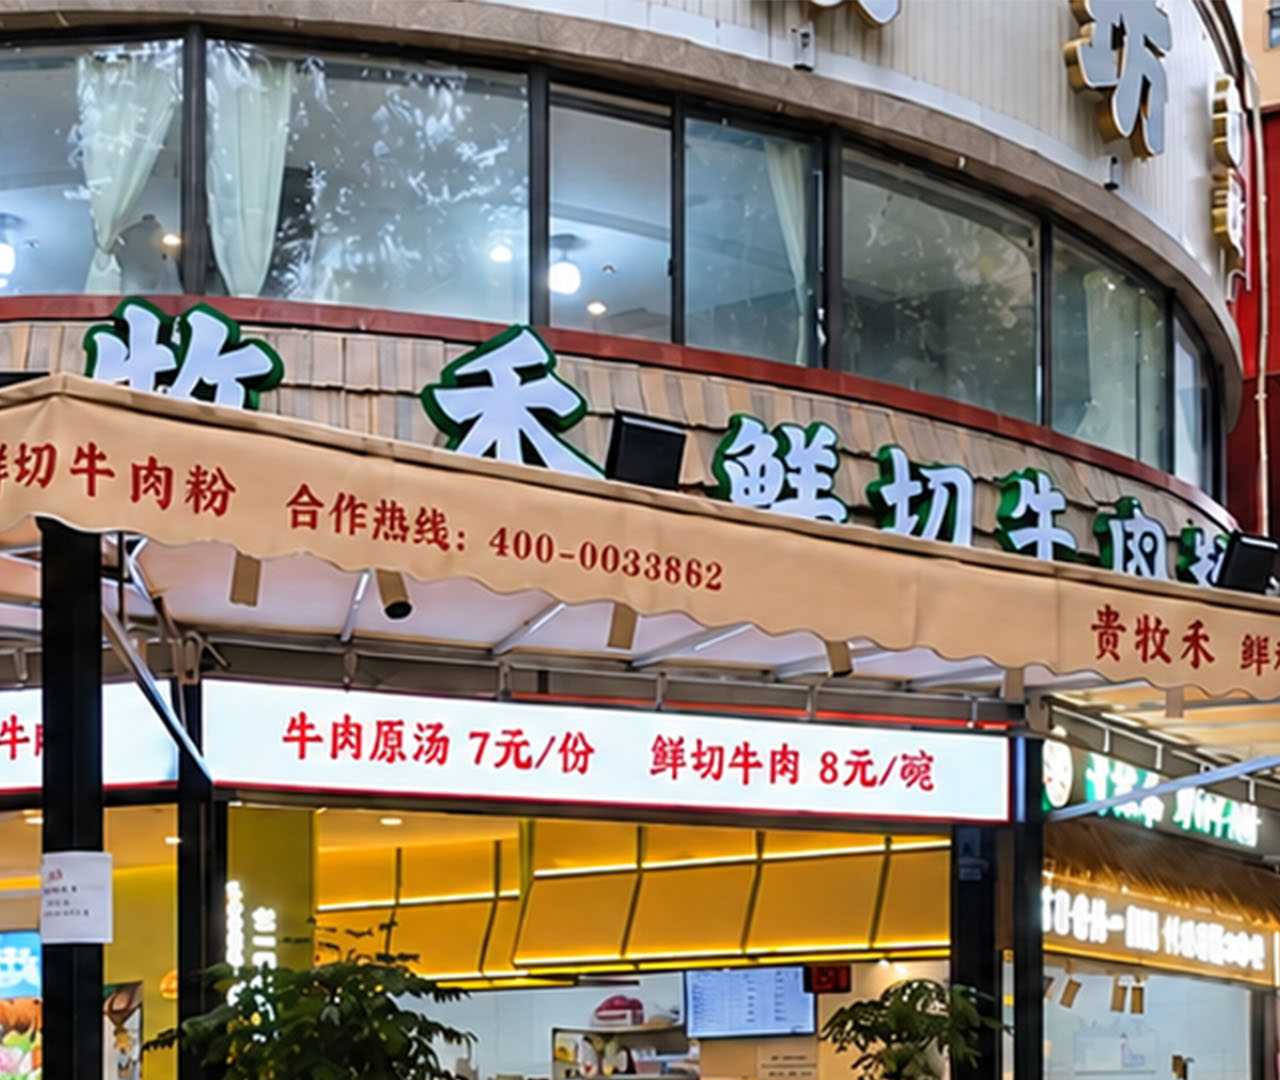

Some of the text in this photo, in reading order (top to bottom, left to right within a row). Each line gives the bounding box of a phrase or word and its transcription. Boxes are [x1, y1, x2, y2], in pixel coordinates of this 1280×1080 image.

[488, 525, 724, 593] 400-0033862
[1093, 606, 1215, 669] 贵牧禾
[282, 711, 935, 792] 牛肉原汤 7元/份 鲜切牛肉 8元/碗
